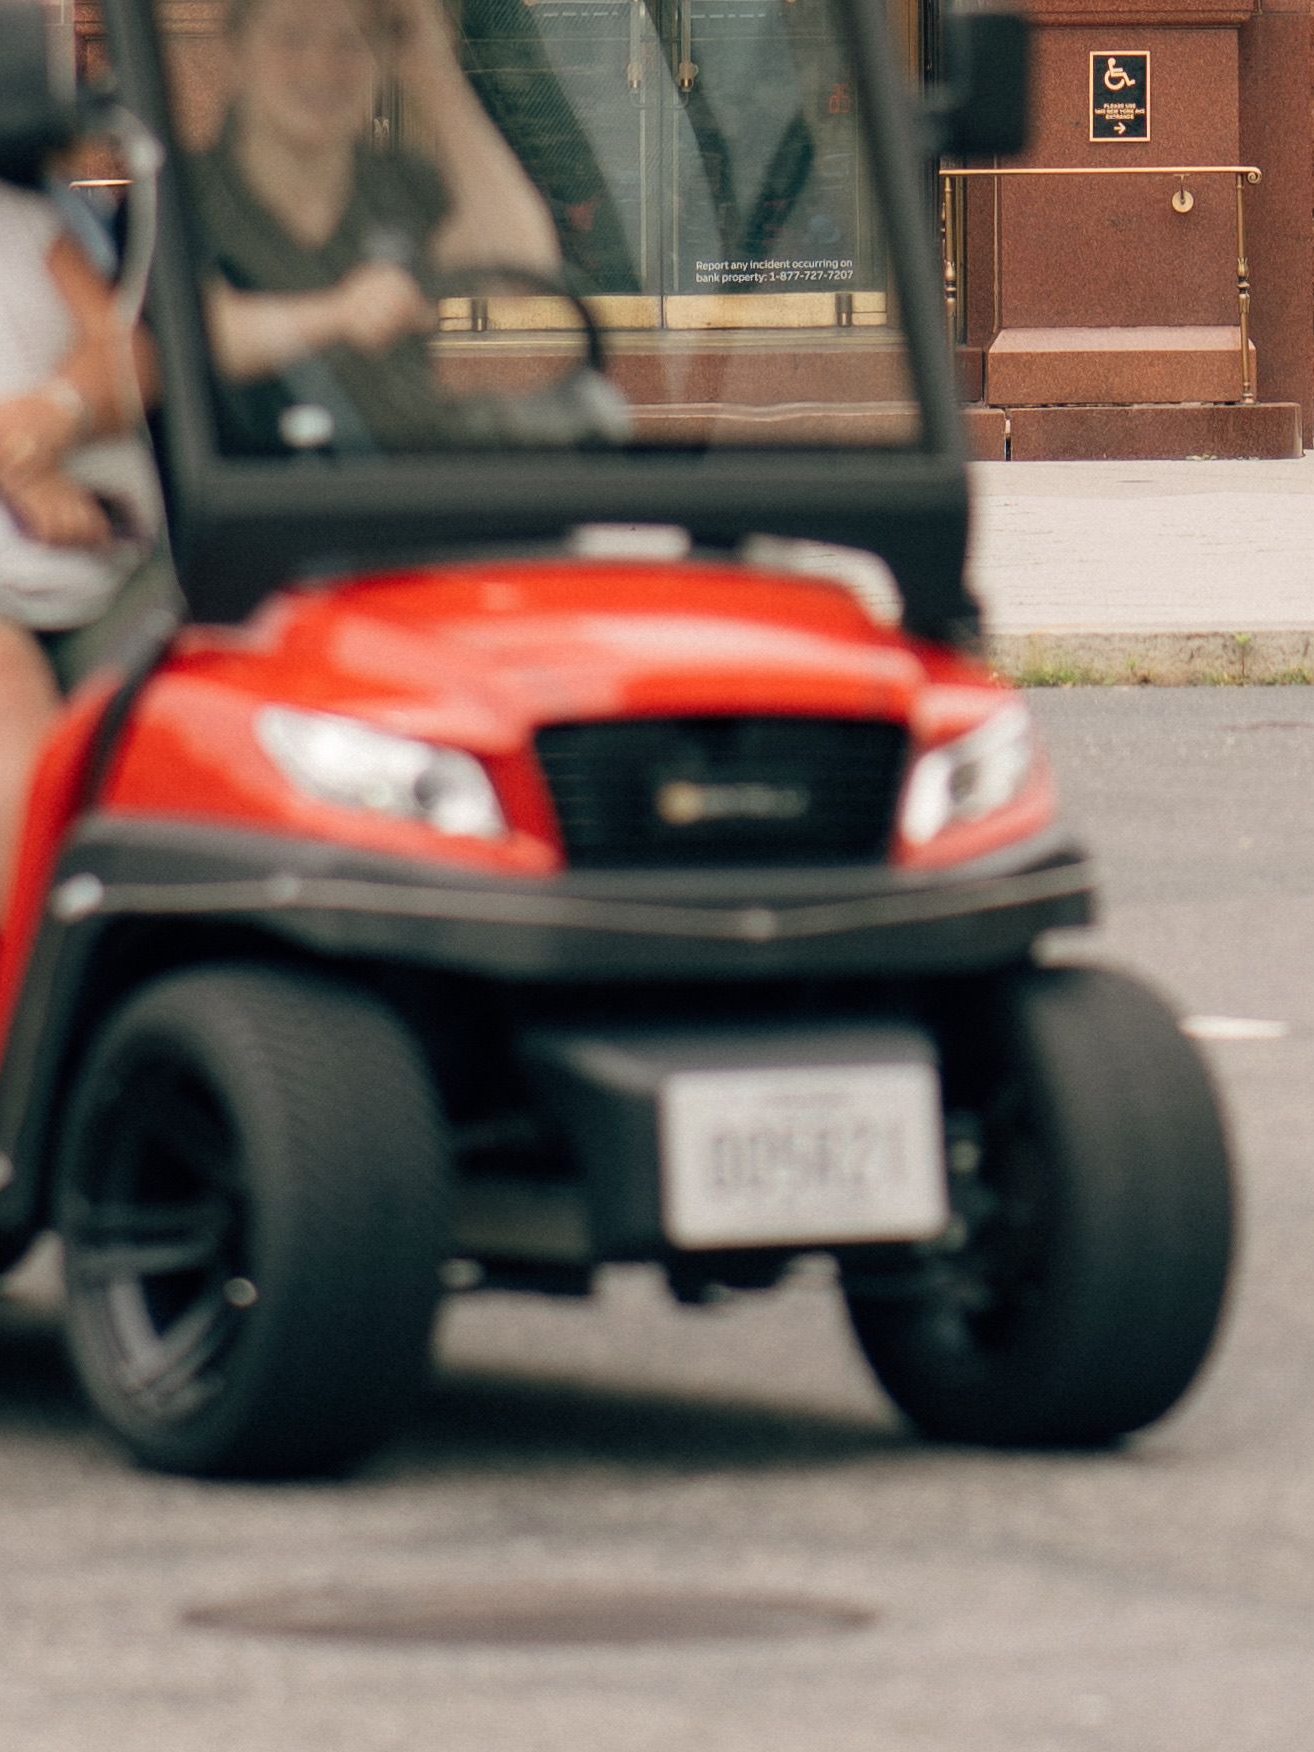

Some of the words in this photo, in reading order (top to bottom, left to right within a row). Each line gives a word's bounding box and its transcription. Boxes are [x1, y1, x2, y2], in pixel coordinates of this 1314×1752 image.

[695, 261, 729, 271] Report
[730, 262, 749, 271] any
[750, 259, 791, 270] incident
[792, 259, 839, 270] occurring
[840, 260, 853, 268] on
[695, 272, 720, 283] bank
[721, 272, 768, 284] property:
[769, 270, 854, 282] 1-877-727-7207
